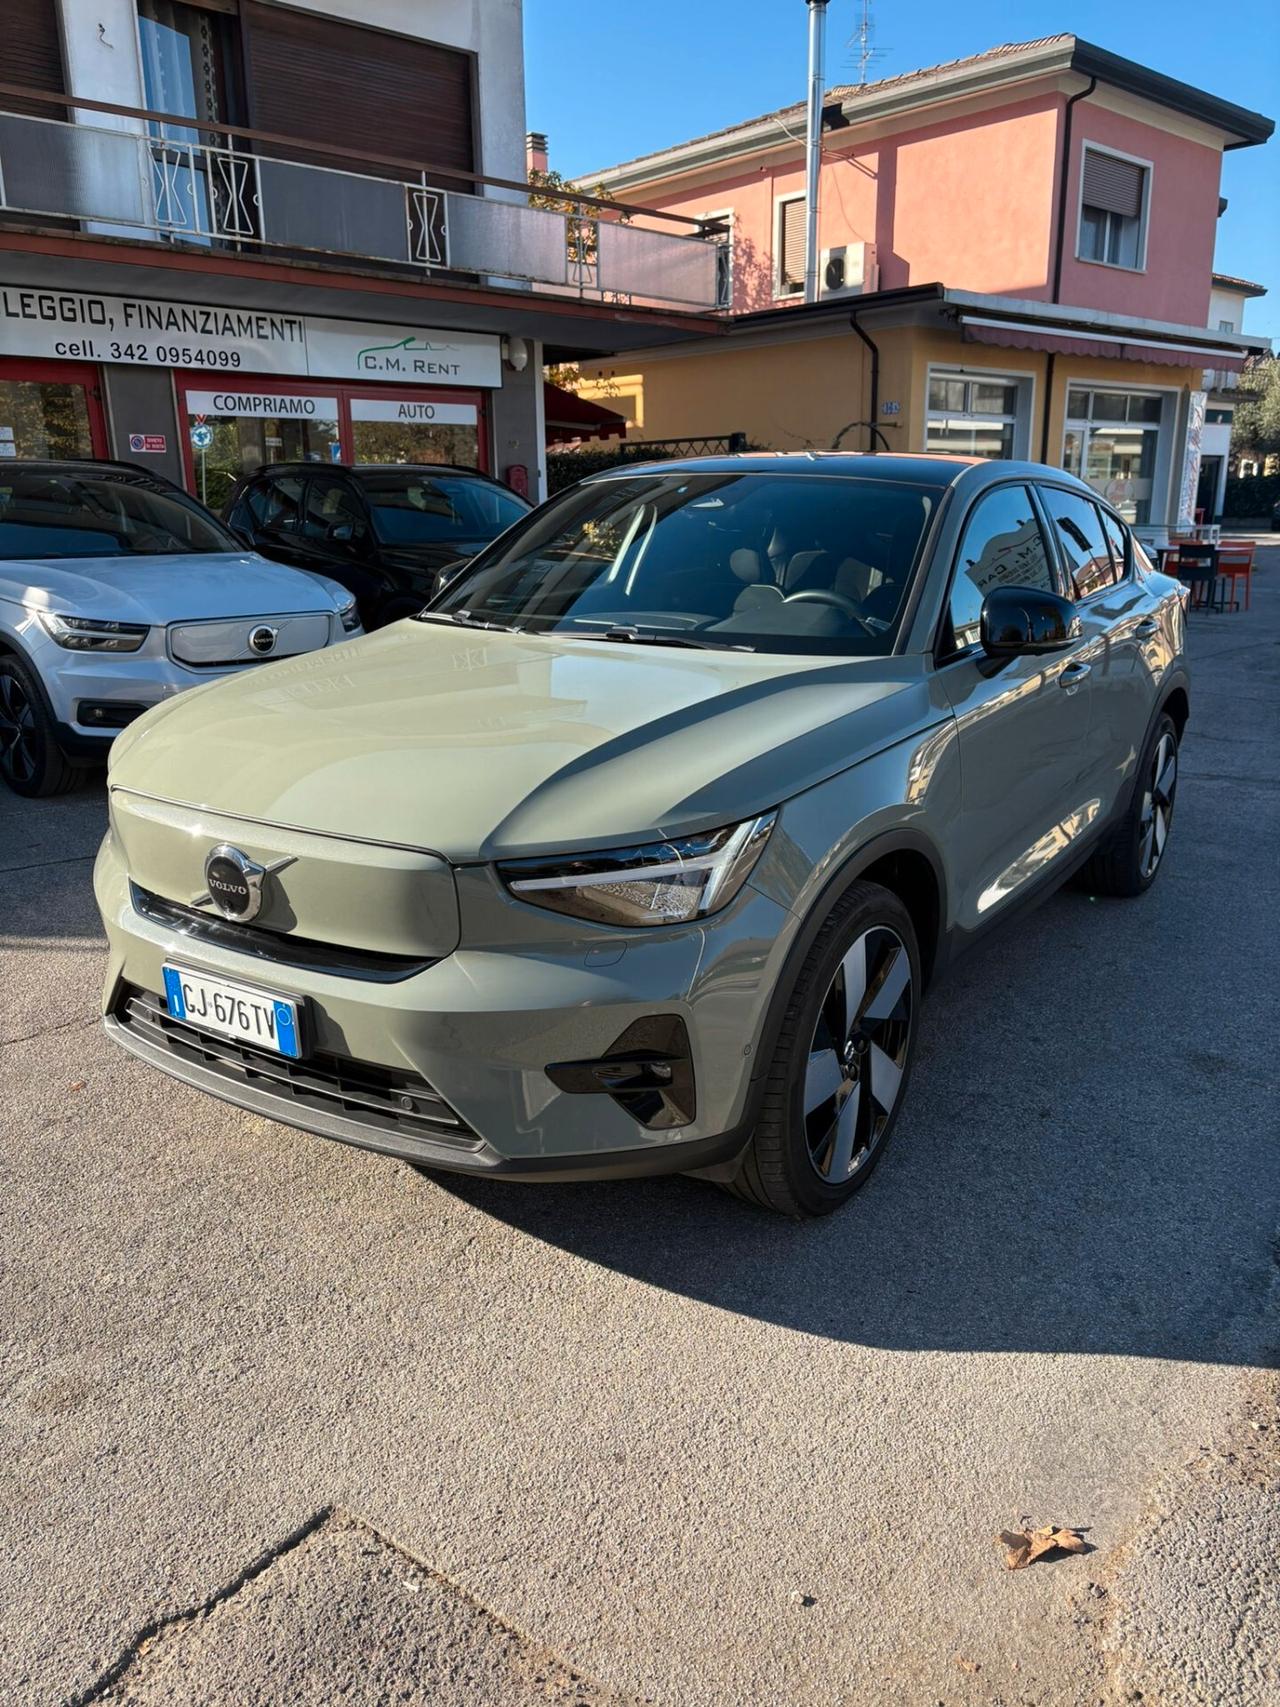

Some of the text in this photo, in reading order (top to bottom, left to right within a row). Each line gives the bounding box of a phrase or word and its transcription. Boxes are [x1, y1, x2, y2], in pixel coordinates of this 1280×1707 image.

[3, 291, 304, 343] LEGGIO, FINANZIAMENTI
[55, 339, 241, 368] cell. 342 0954099
[364, 355, 406, 373] C.M.
[213, 394, 316, 415] COMPRIAMO
[398, 404, 436, 420] AUTO
[208, 878, 248, 896] VOLVO
